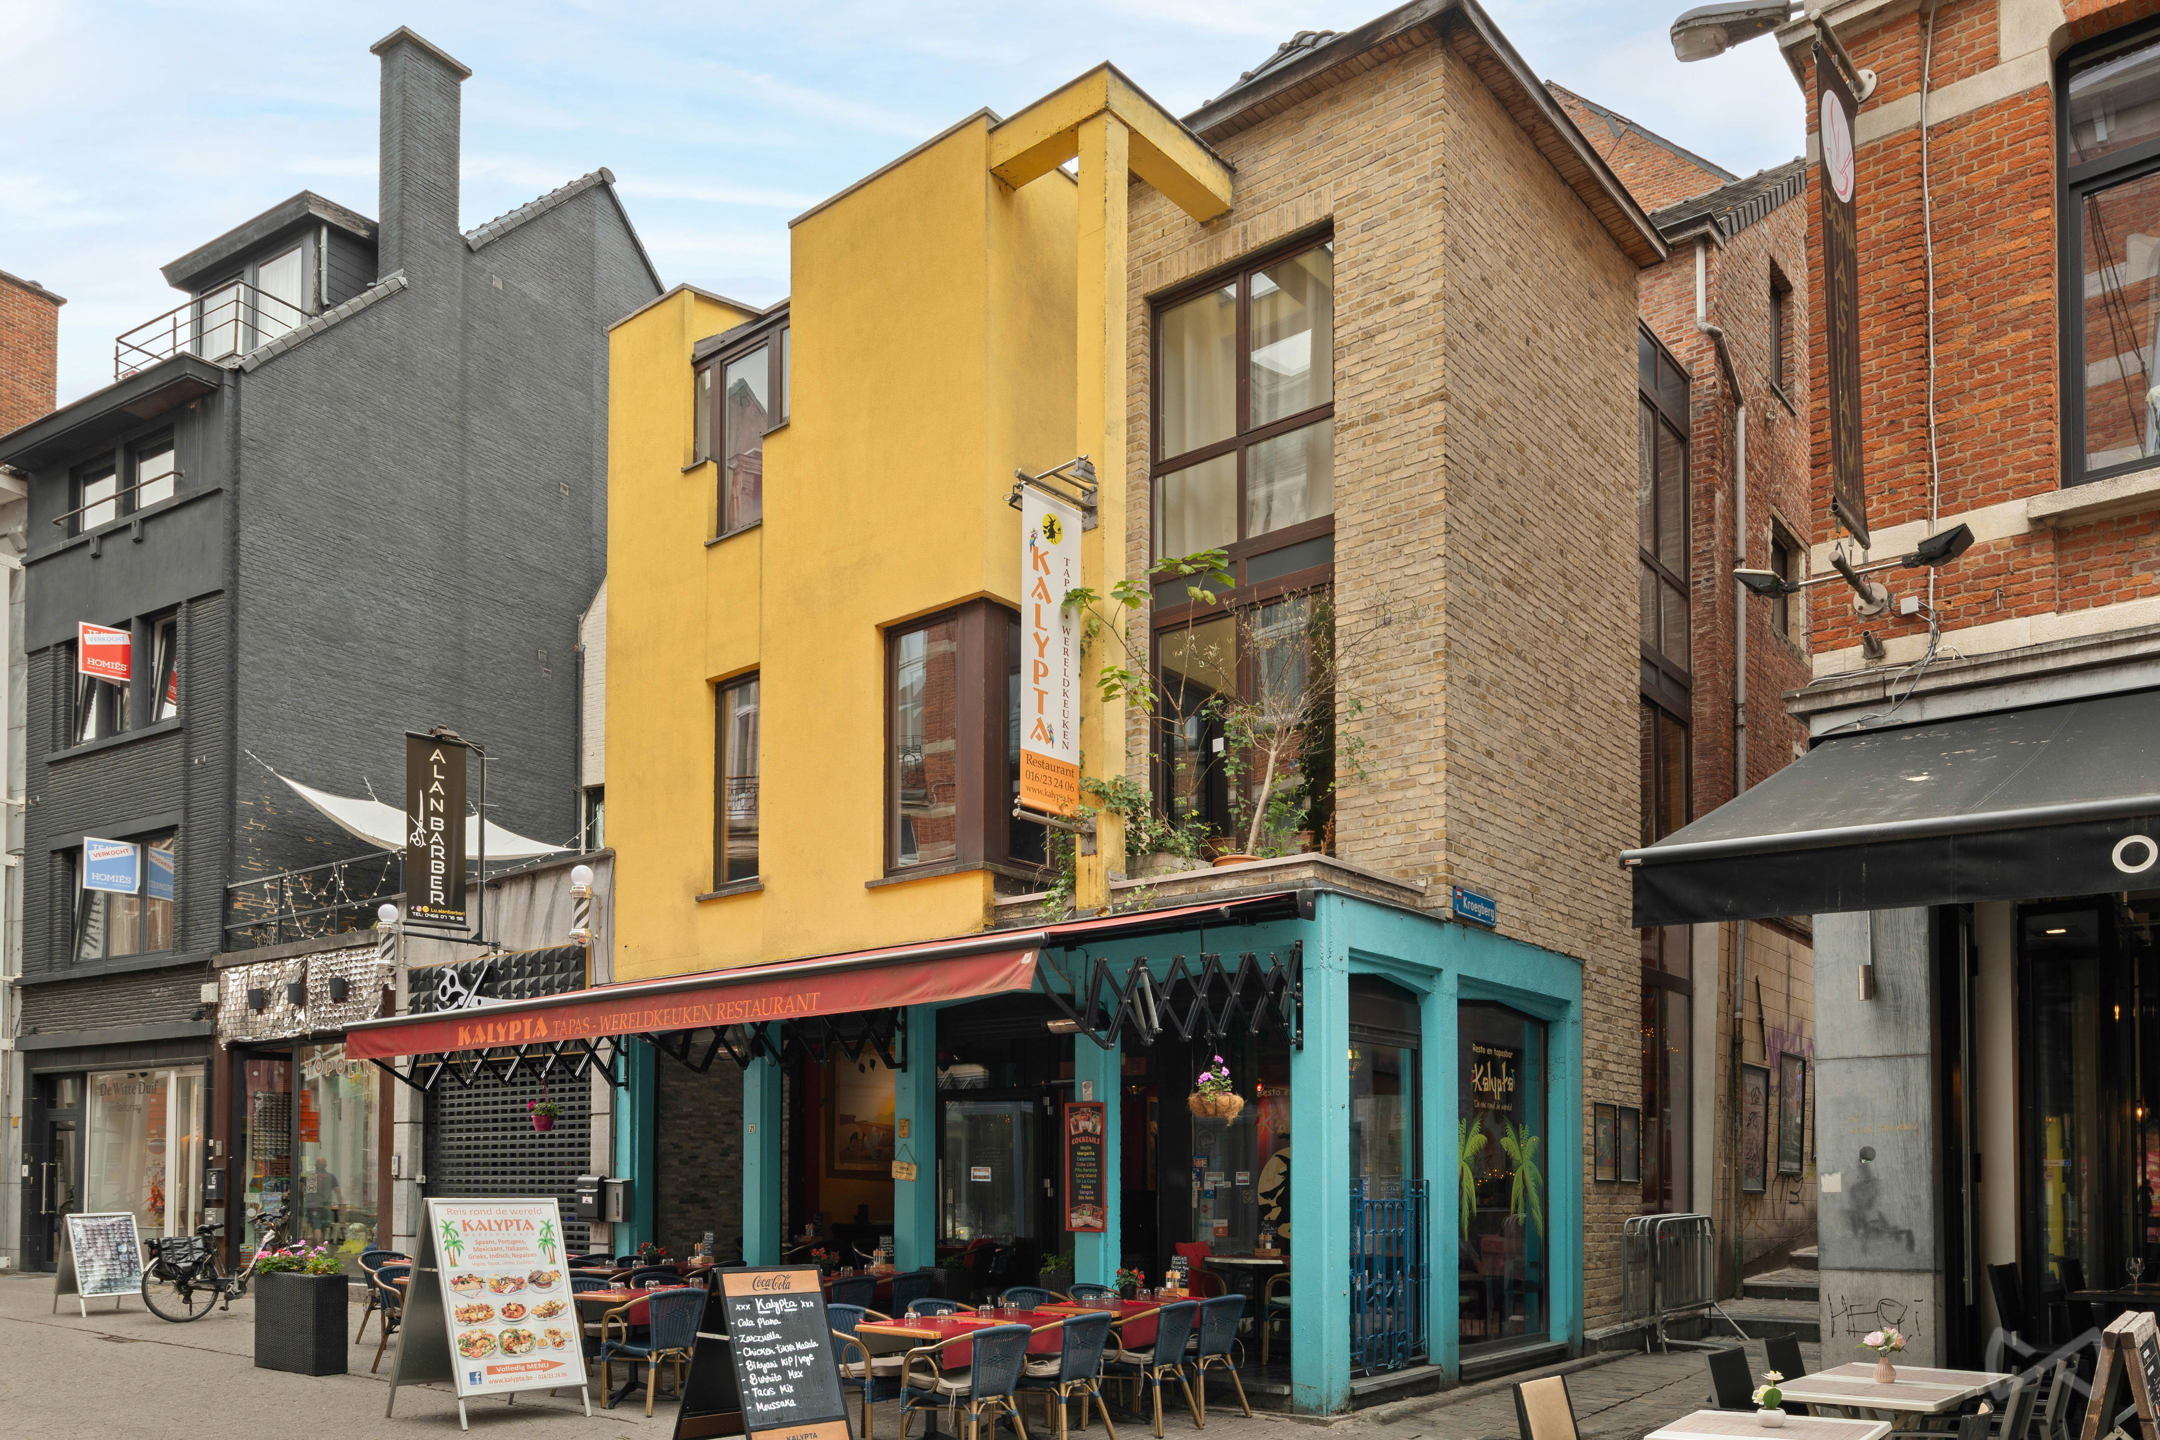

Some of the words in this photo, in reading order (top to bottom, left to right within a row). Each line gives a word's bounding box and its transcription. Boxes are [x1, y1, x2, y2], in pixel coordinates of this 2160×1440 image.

[1031, 546, 1052, 745] KALYPTA
[1062, 626, 1071, 750] WERELDKEUKEN
[1026, 753, 1075, 778] Restaurant
[429, 749, 446, 812] ALAN
[1025, 770, 1053, 786] 016/23
[1054, 778, 1063, 790] 24
[1065, 781, 1075, 793] 06
[93, 848, 129, 858] VERKOCHT
[429, 817, 446, 905] BARBER
[1463, 896, 1494, 921] Kroegberg
[458, 1016, 548, 1046] KALYPTA
[553, 1017, 591, 1037] TAPAS
[600, 1004, 713, 1032] WERELDKEUKEN
[716, 992, 820, 1021] RESTAURANT
[1472, 1061, 1514, 1100] Kalypta
[446, 1208, 467, 1216] Reis
[469, 1207, 493, 1216] rond
[495, 1207, 508, 1215] de
[510, 1207, 542, 1215] wereld
[461, 1219, 535, 1232] KALYPTA
[496, 1365, 525, 1373] Volledig
[526, 1362, 549, 1370] MENU
[749, 1373, 782, 1385] Burrito
[752, 1387, 776, 1397] Tacos
[780, 1384, 794, 1394] Mix
[756, 1399, 796, 1412] Moussaka
